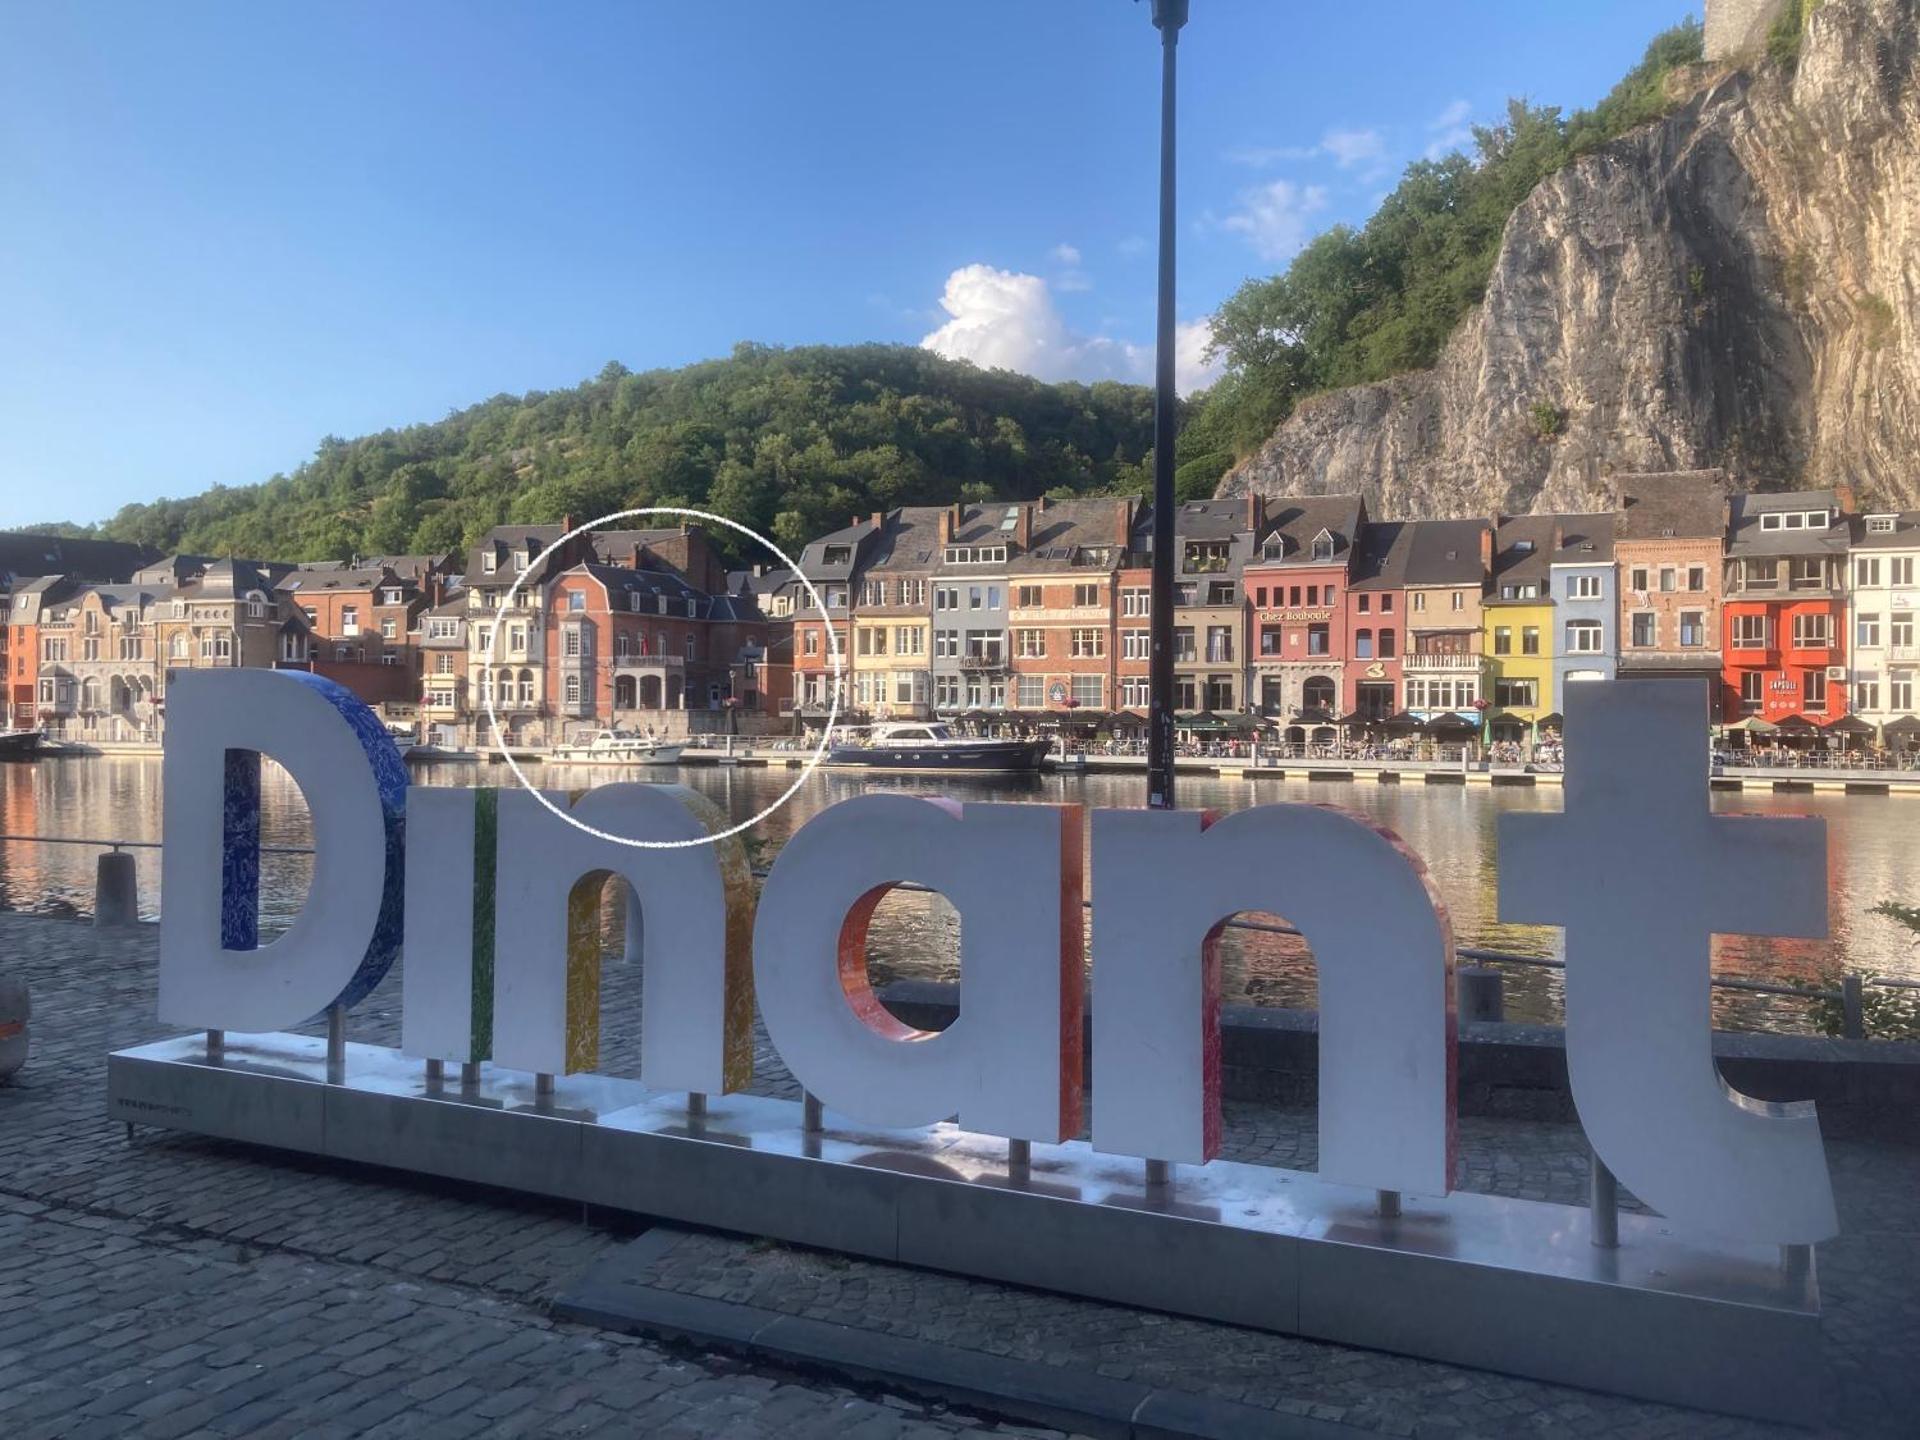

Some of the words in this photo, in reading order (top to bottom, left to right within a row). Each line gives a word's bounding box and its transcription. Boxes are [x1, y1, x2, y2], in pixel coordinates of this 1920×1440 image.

[1260, 611, 1285, 621] Chez
[1286, 610, 1331, 620] Bouboule
[158, 669, 1839, 1244] Dinant
